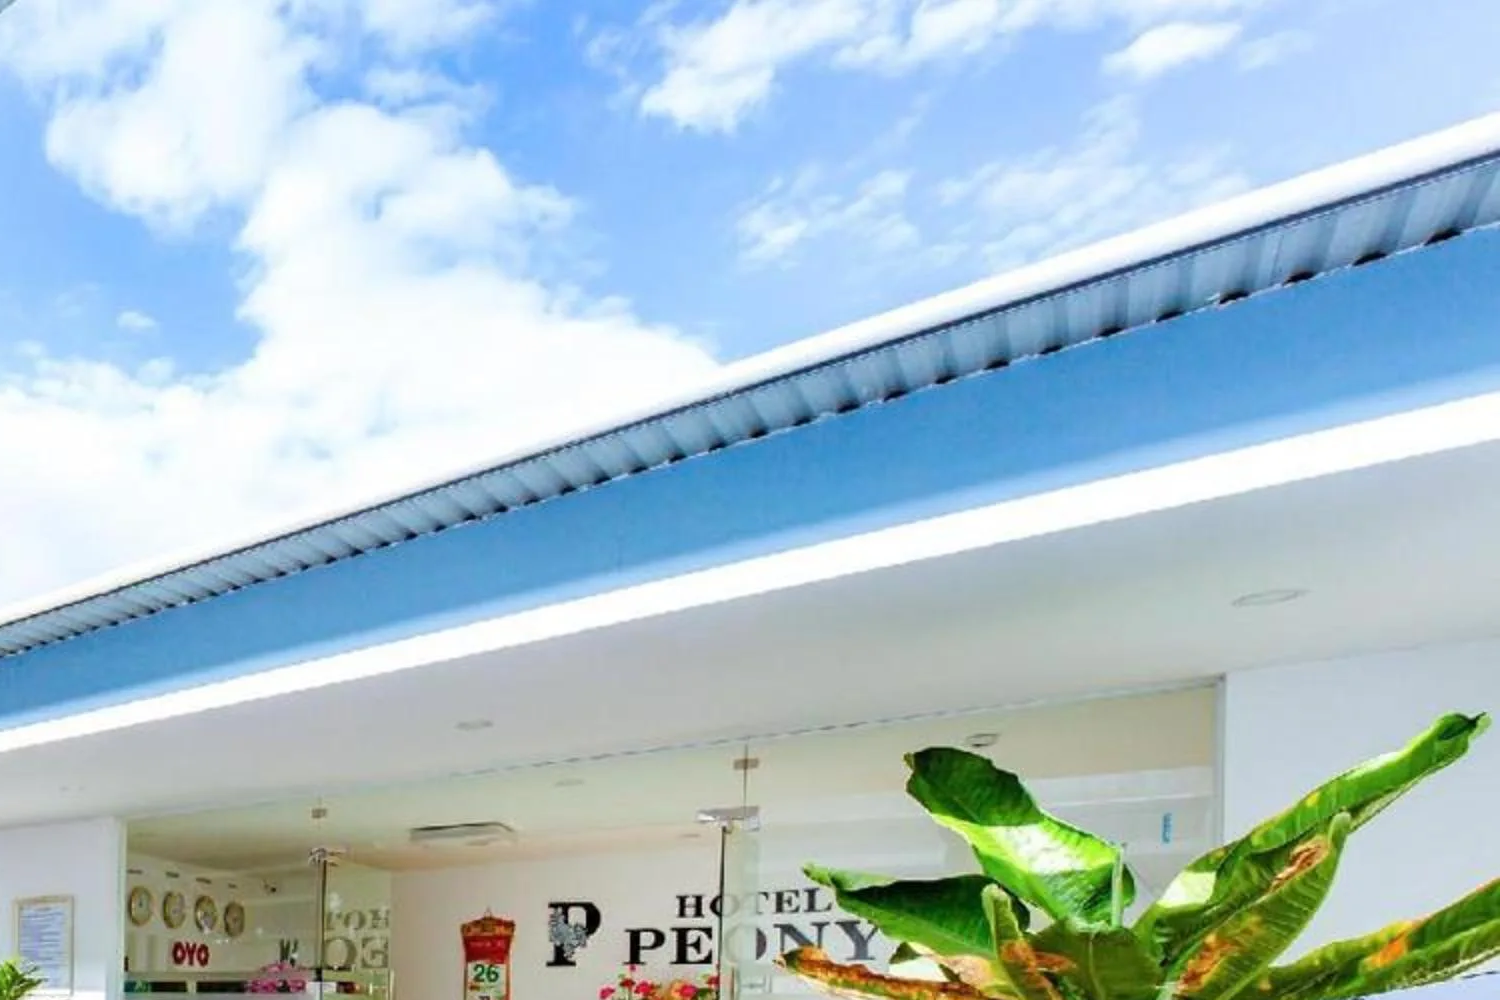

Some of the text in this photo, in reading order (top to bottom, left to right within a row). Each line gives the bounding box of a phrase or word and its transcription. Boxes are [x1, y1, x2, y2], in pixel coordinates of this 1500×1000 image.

[676, 887, 832, 918] HOTEL
[172, 941, 210, 967] OYO
[622, 920, 879, 966] PEONY
[473, 963, 500, 983] 26
